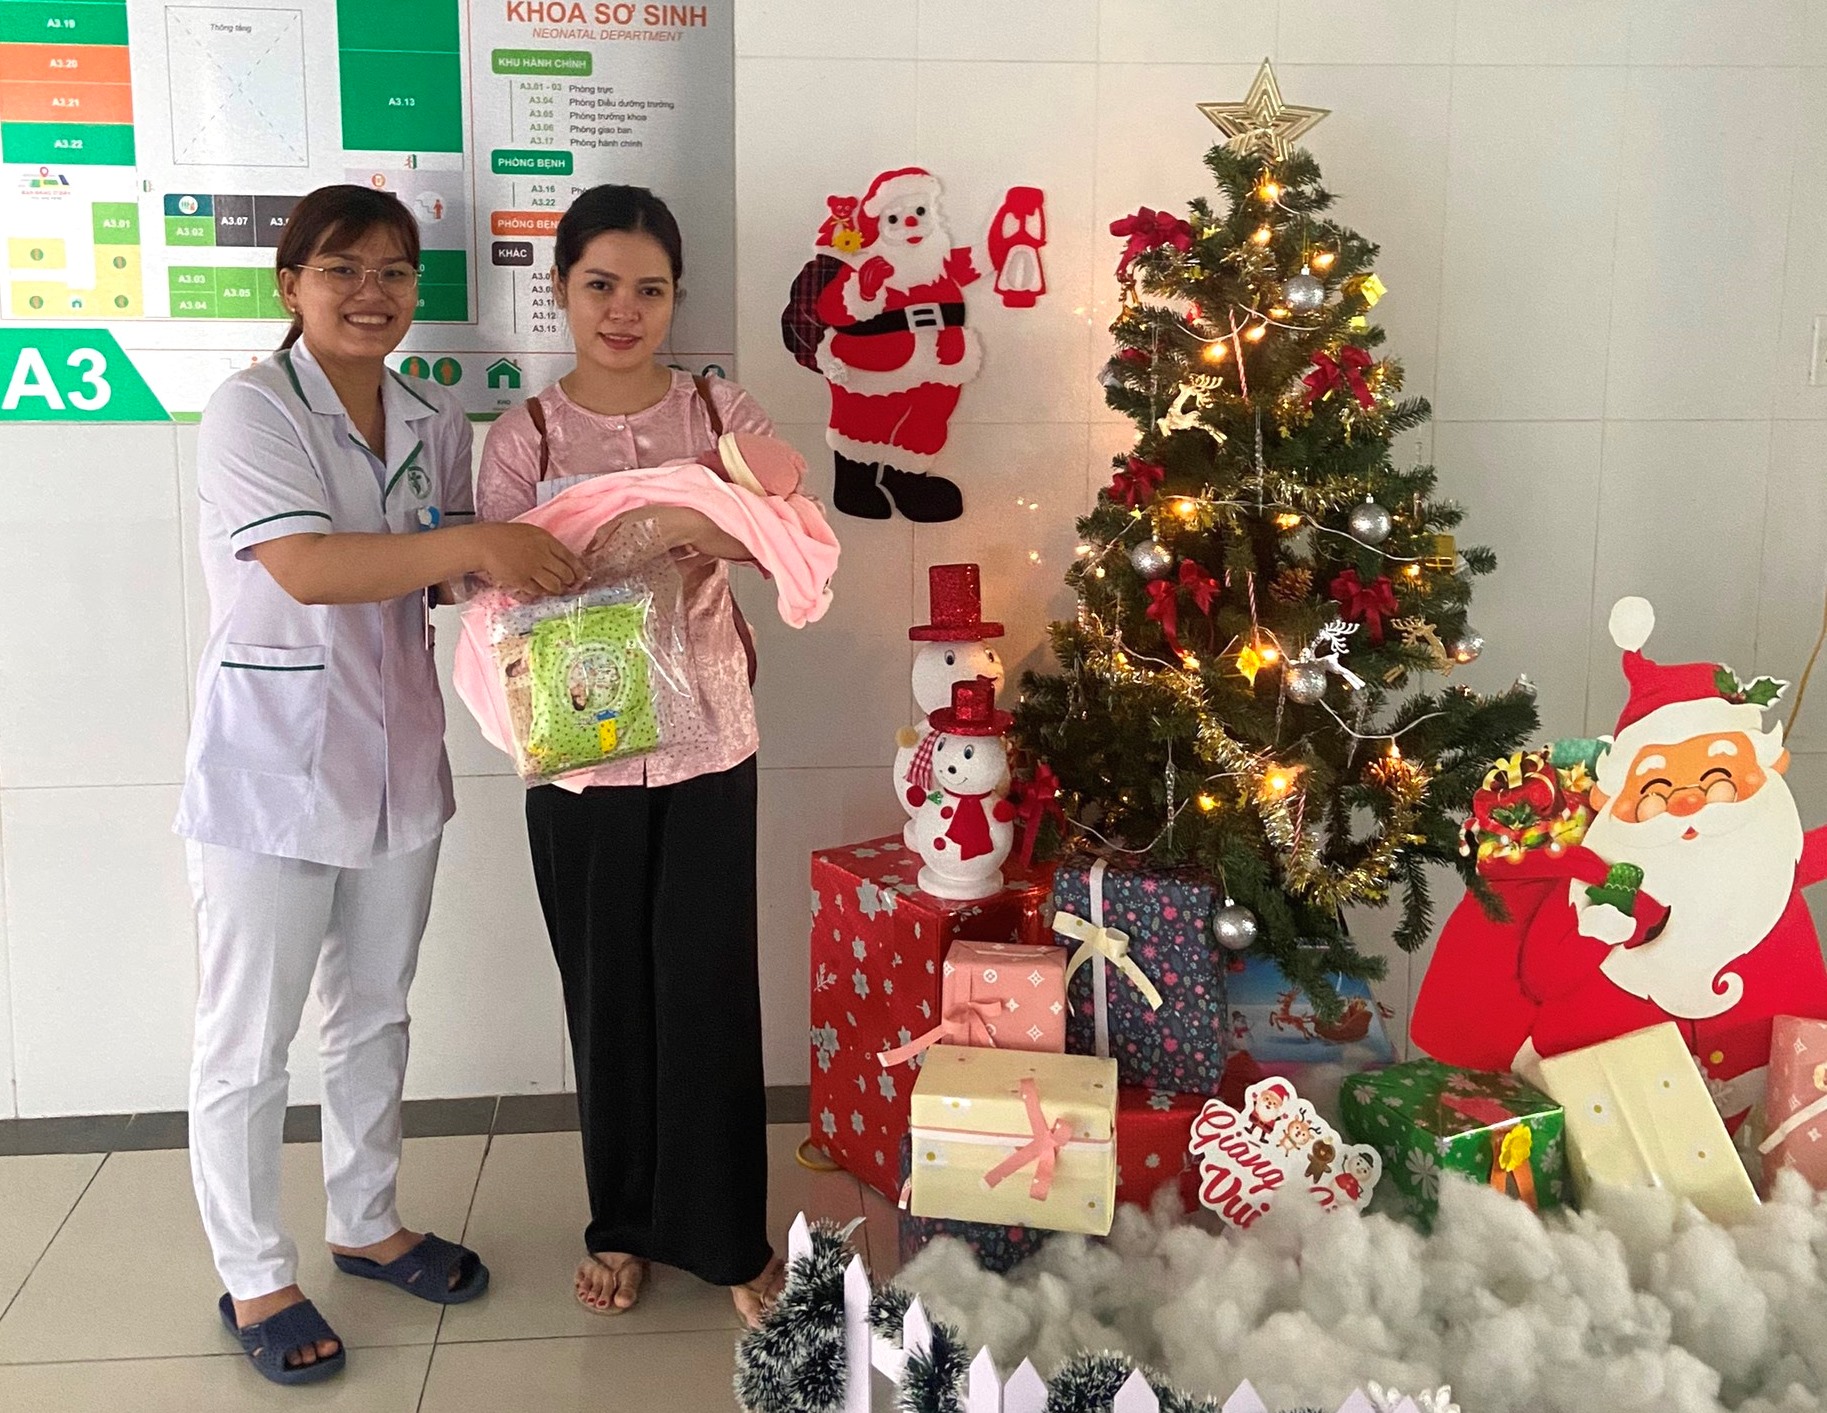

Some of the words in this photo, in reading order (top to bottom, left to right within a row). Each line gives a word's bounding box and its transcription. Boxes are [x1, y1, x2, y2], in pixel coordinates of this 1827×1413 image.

[507, 1, 587, 24] KHOA
[594, 3, 636, 26] SƠ
[643, 5, 707, 28] SINH
[532, 27, 597, 40] NEONATAL
[600, 29, 684, 43] DEPARTMENT
[498, 58, 520, 67] KHU
[522, 56, 552, 68] HÀNH
[388, 97, 416, 107] A3.13
[497, 157, 535, 168] PHÒNG
[536, 158, 566, 170] BỆNH
[531, 185, 556, 194] A3.16
[531, 199, 556, 207] A3.22
[221, 216, 249, 226] A3.07
[497, 217, 535, 229] PHÒNG
[536, 219, 560, 231] BỆN
[176, 226, 204, 237] A3.02
[498, 247, 528, 258] KHÁC
[178, 275, 206, 284] A3.03
[531, 272, 551, 281] A3.0
[223, 288, 251, 298] A3.05
[179, 300, 207, 310] A3.04
[532, 311, 557, 320] A3.12
[532, 324, 557, 333] A3.15
[1, 347, 112, 411] A3
[1193, 1103, 1285, 1195] Giáng
